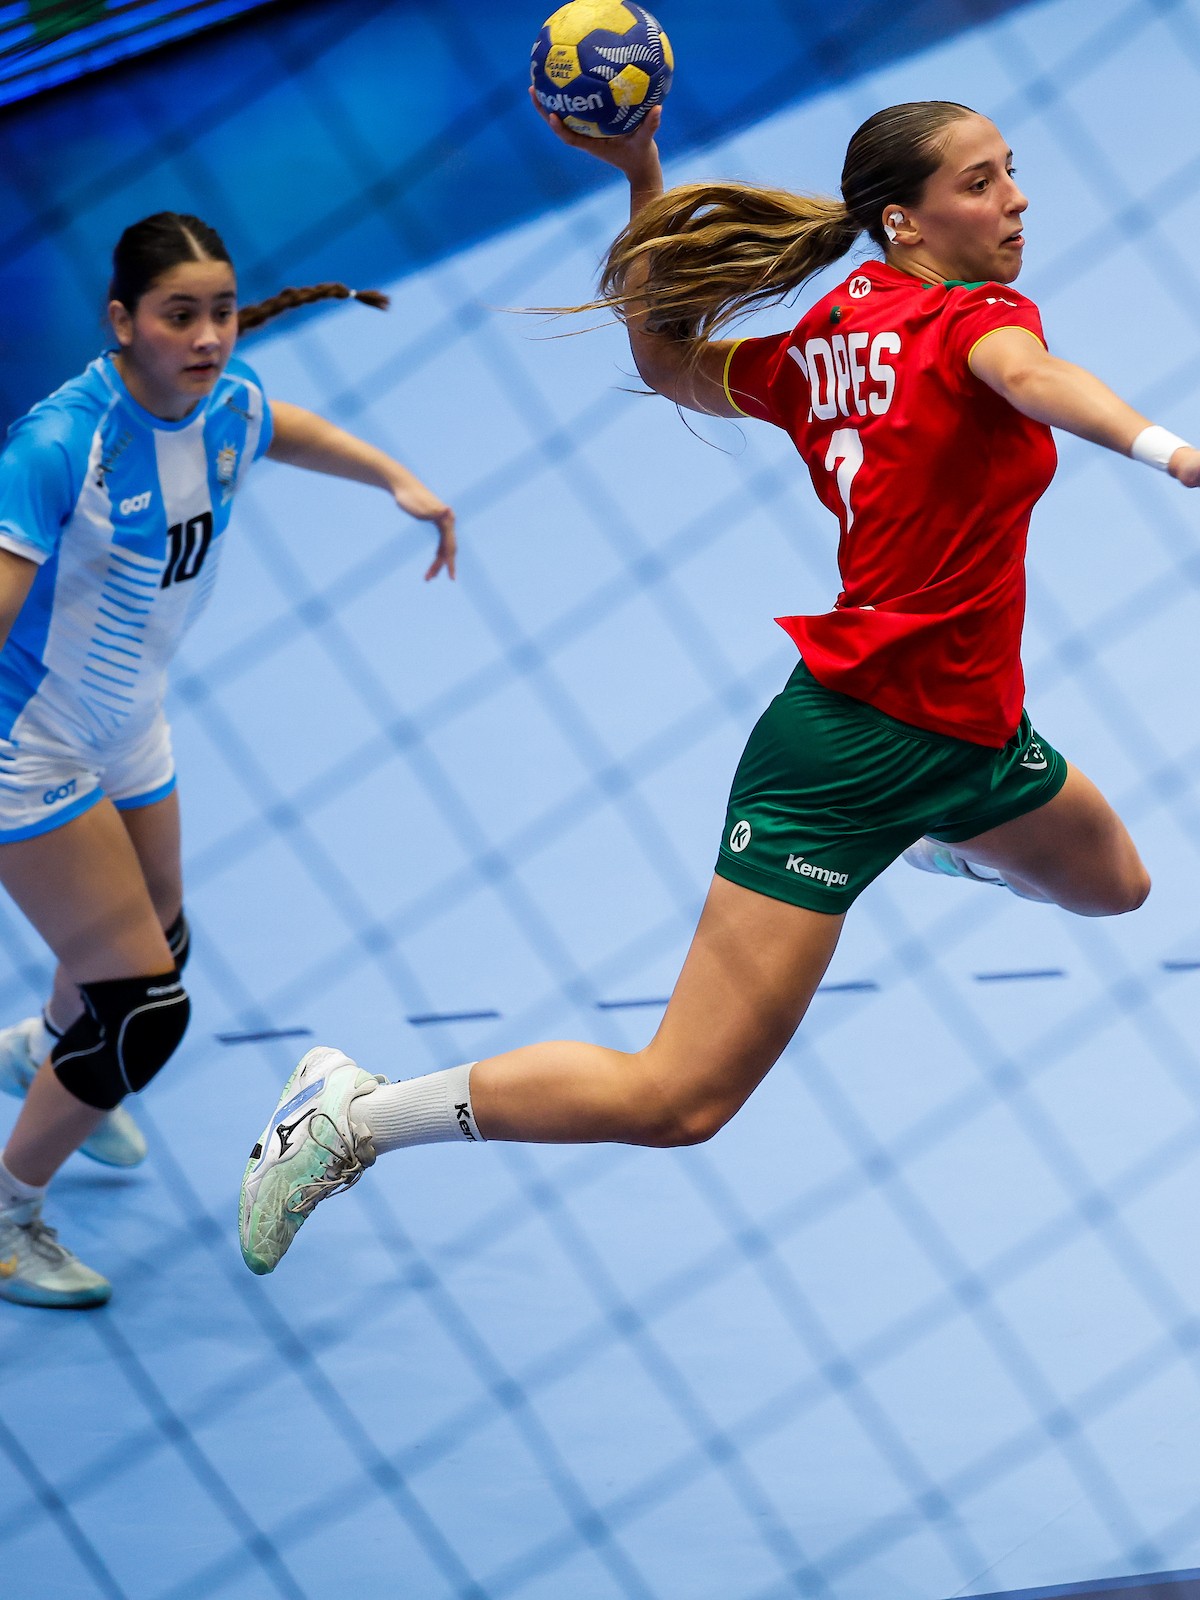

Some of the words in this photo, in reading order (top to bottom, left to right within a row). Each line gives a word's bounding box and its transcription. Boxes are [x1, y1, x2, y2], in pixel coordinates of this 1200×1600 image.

[549, 62, 573, 72] GAME
[551, 70, 571, 79] BALL
[824, 427, 864, 534] 7
[160, 511, 213, 589] 10
[785, 853, 849, 887] Kempa
